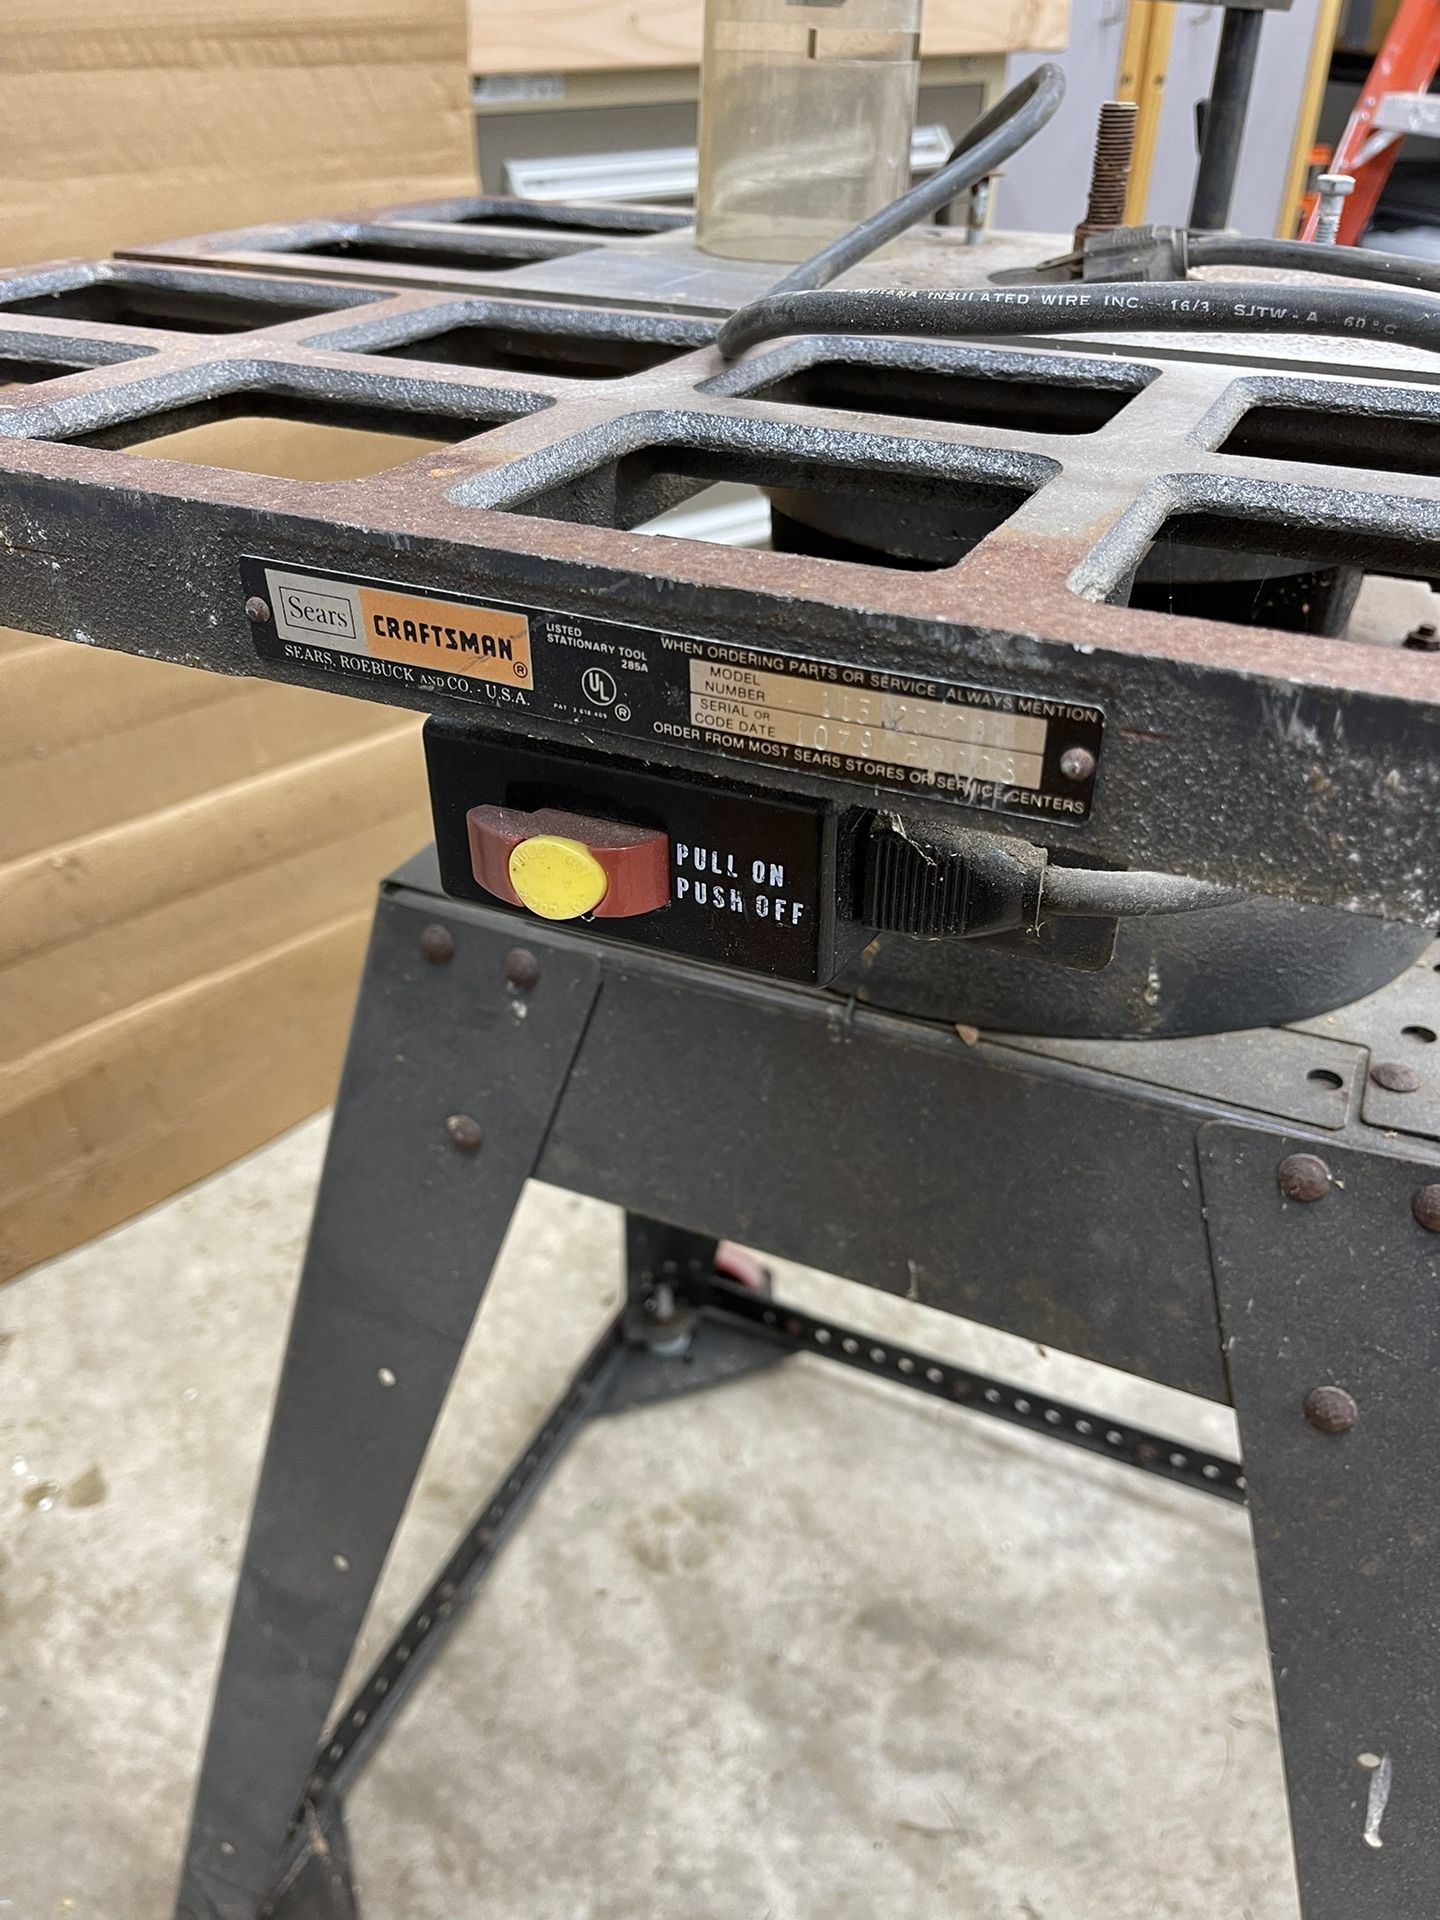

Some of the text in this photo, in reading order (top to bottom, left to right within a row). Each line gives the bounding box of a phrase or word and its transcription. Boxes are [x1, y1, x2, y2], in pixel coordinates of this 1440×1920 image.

[927, 290, 1030, 306] INSULATED
[1041, 294, 1091, 307] WIRE
[1103, 295, 1144, 309] INC.
[1170, 299, 1211, 313] 16/3
[288, 595, 348, 628] Sears
[373, 614, 513, 661] CRAFTSMAN
[546, 623, 582, 637] LISTED
[546, 633, 647, 661] STATIONARY TOOL
[340, 655, 415, 682] ROEBUCK
[420, 674, 445, 687] AND
[447, 676, 473, 694] CO.
[485, 684, 531, 706] U.S.A.
[621, 660, 649, 673] 285A
[660, 637, 1098, 724] WHEN ORDERING PARTS OR SERVICE ALWAYS MENTION
[710, 667, 760, 686] MODEL
[705, 681, 766, 702] NUMBER
[700, 699, 770, 721] SERIAL OR
[695, 712, 734, 730] CODE
[739, 720, 776, 738] DATE
[653, 721, 1085, 814] ORDER FROM MOST SEARS STORES OR SERVICE CENTERS
[676, 842, 784, 888] PULL ON
[676, 877, 804, 925] PUSH OFF
